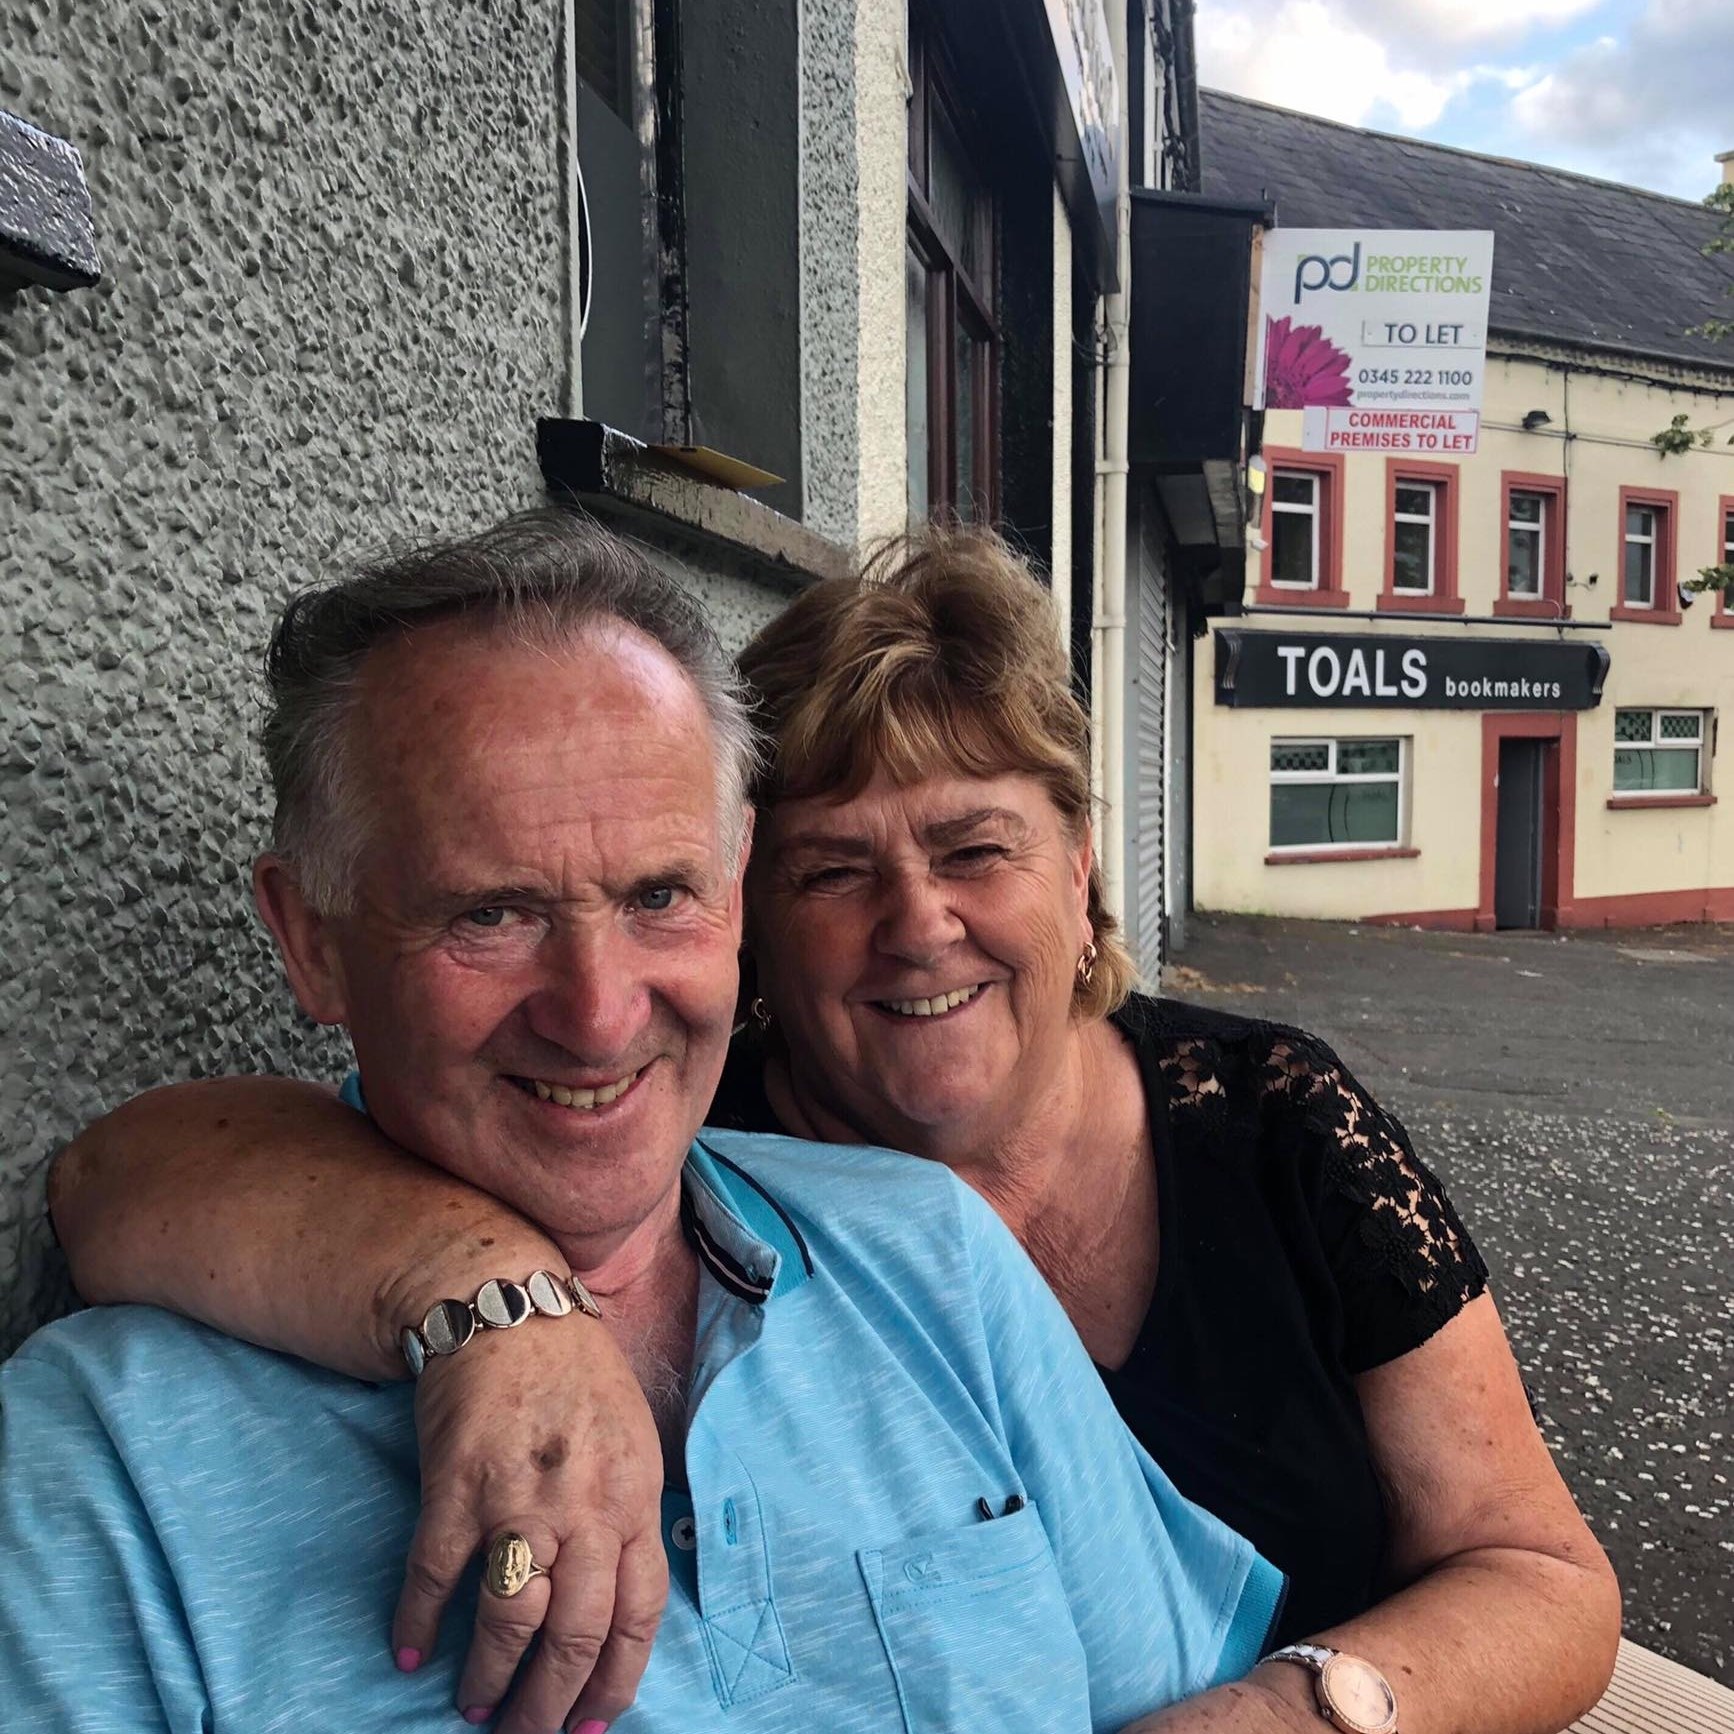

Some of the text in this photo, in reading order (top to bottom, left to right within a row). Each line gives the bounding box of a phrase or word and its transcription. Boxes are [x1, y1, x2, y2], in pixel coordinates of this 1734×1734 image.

[1367, 256, 1468, 275] PROPERTY
[1365, 275, 1482, 294] DIRECTIONS
[1384, 323, 1464, 345] TO LET
[1358, 369, 1473, 386] 0345 222 1100
[1356, 389, 1471, 401] propertydirections.com
[1349, 412, 1457, 429] COMMERCIAL
[1330, 432, 1473, 449] PREMISES TO LET
[1277, 646, 1561, 698] TOALS bookmakers
